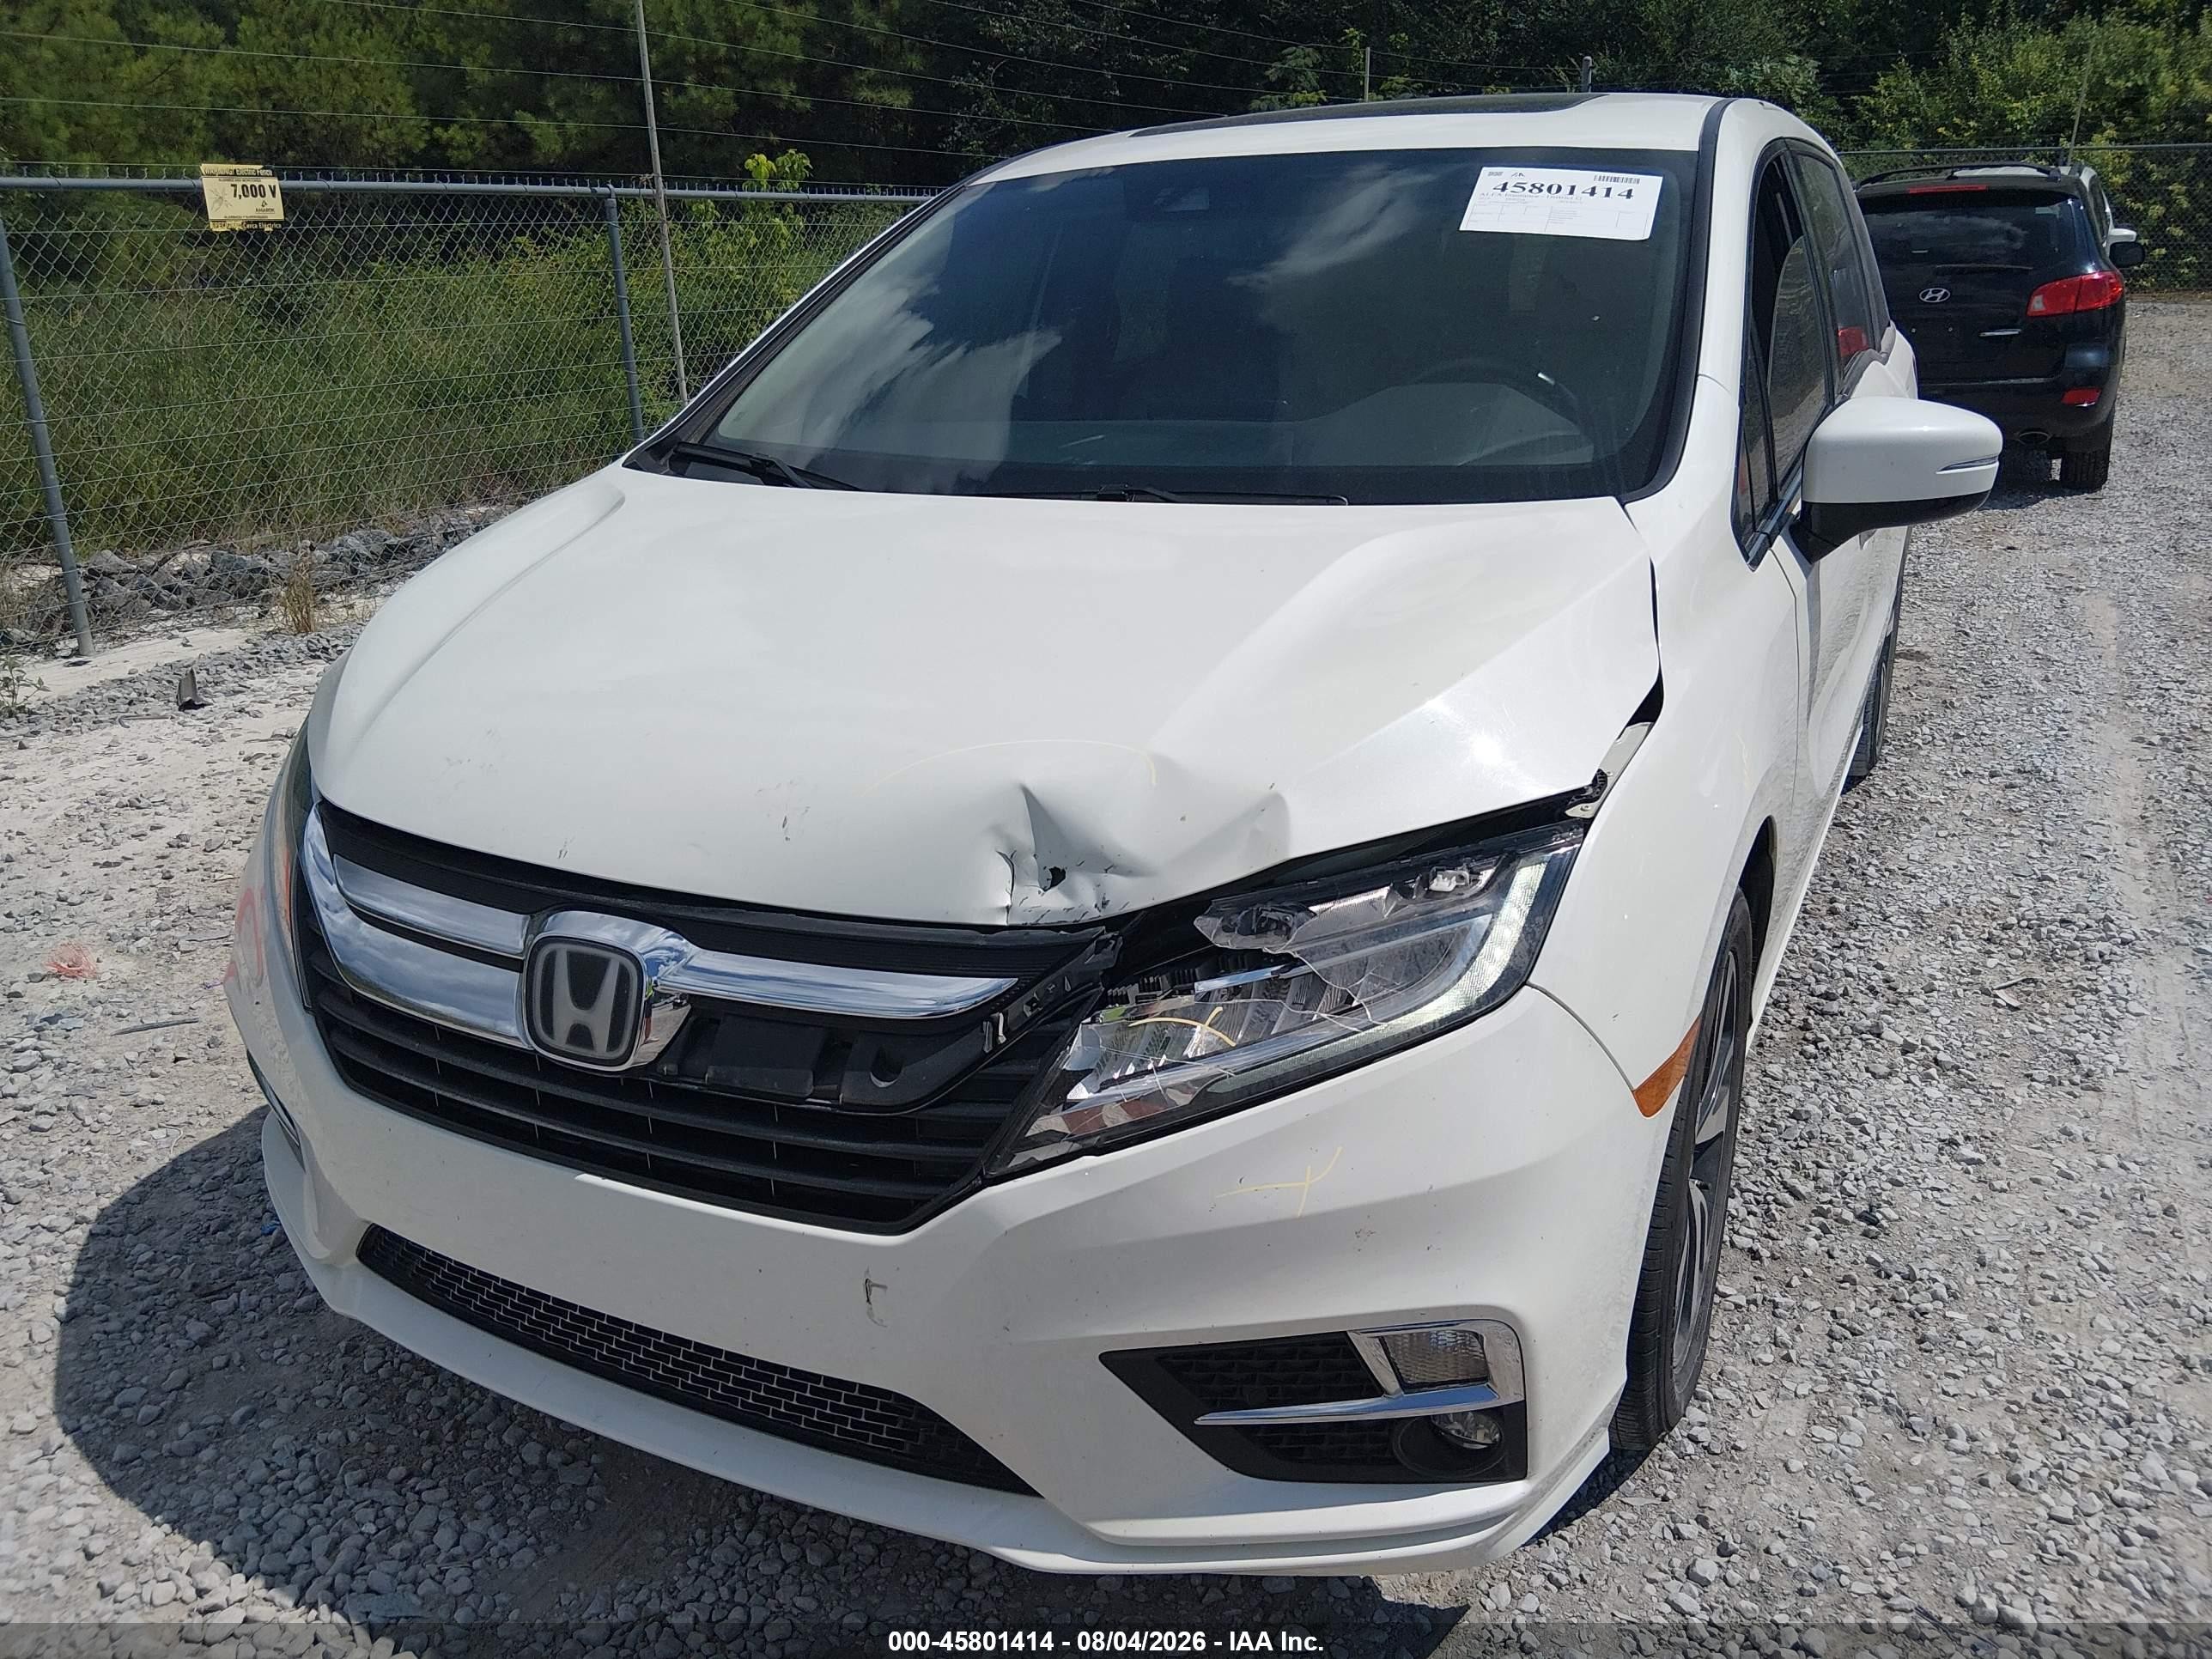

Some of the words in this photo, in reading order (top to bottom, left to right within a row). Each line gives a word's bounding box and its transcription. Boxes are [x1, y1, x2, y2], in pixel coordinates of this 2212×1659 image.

[230, 184, 266, 199] 7,000
[268, 184, 276, 198] V
[1492, 181, 1634, 200] 45801414
